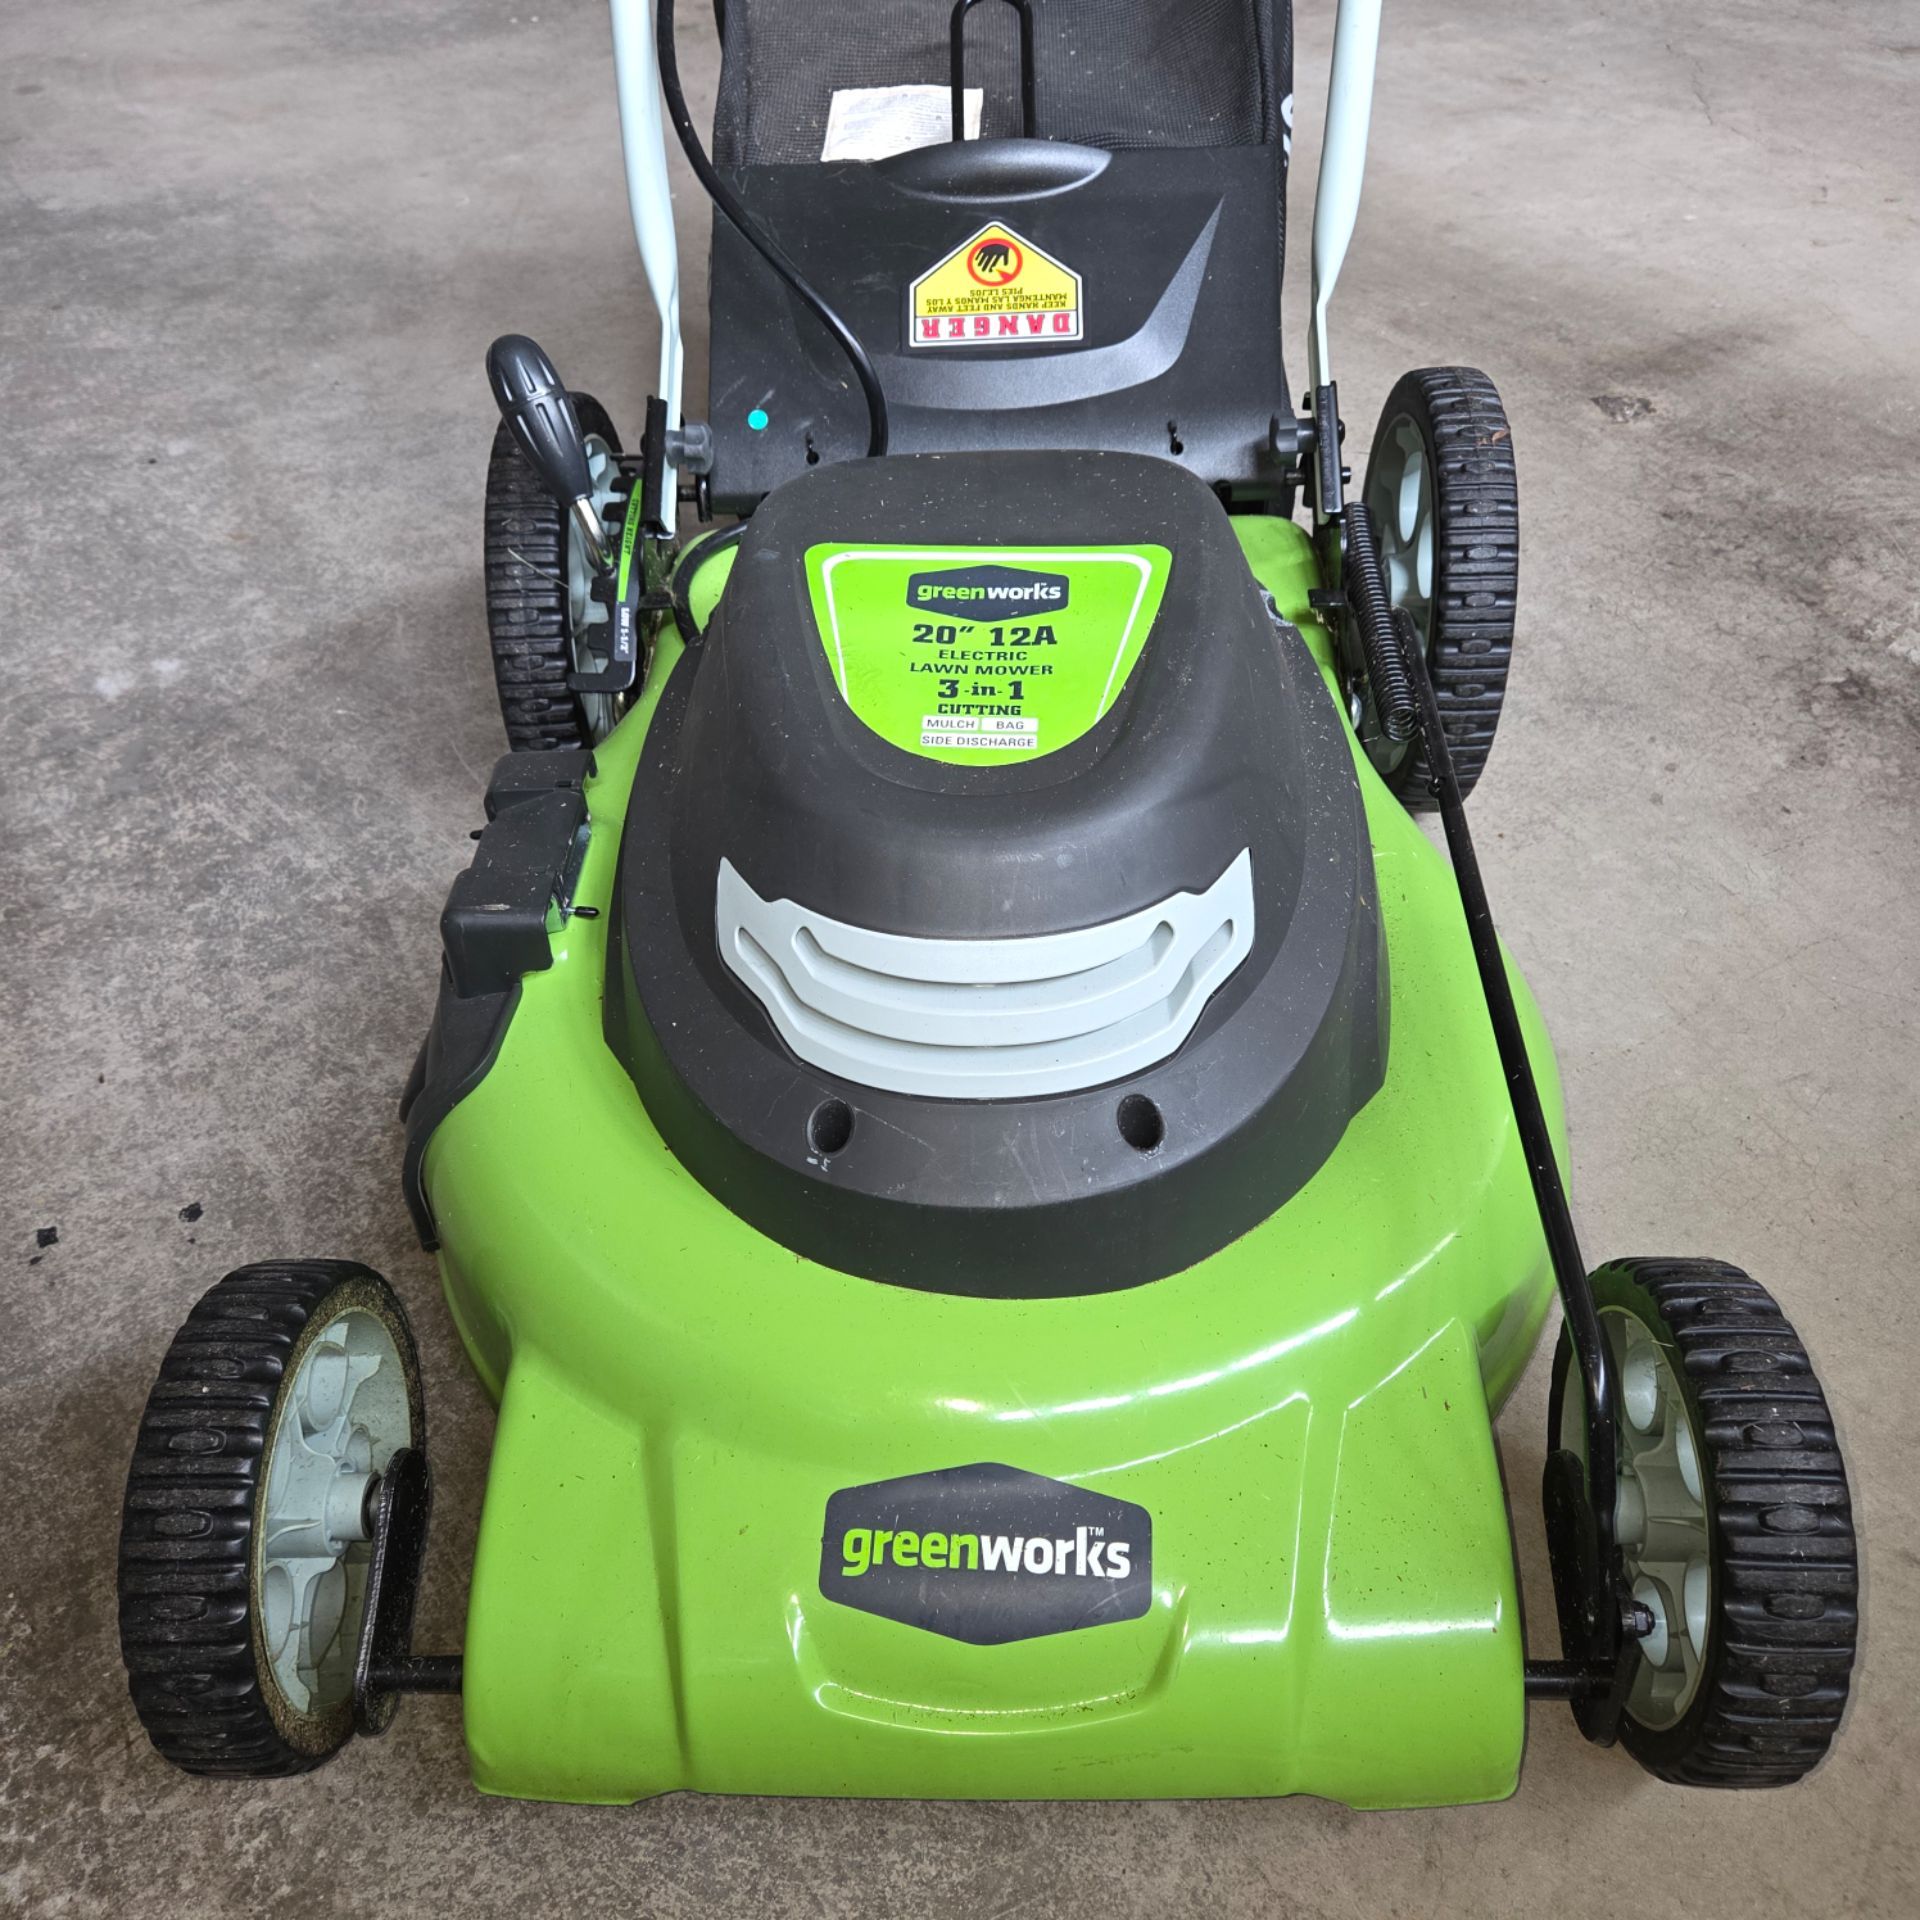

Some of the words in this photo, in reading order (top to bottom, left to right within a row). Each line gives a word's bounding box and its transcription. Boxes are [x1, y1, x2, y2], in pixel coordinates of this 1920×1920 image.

[969, 288, 999, 297] LEJOS
[1001, 287, 1024, 295] PIES
[926, 298, 945, 306] LOS
[946, 297, 952, 305] Y
[954, 296, 989, 305] MANOS
[992, 295, 1010, 304] LAS
[1012, 293, 1067, 303] MANTENGA
[956, 304, 981, 312] FEET
[983, 303, 1004, 311] AND
[1006, 301, 1039, 310] HANDS
[1041, 300, 1066, 309] KEEP
[927, 305, 953, 314] AWAY
[921, 313, 1070, 338] DANGER
[917, 582, 1061, 601] greenworks
[620, 606, 630, 627] LOW
[989, 625, 1058, 646] 12A
[938, 649, 1028, 661] ELECTRIC
[910, 662, 969, 674] LAWN
[975, 665, 1054, 675] MOWER
[937, 703, 1021, 716] CUTTING
[926, 718, 975, 729] MULCH
[996, 721, 1025, 730] BAG
[922, 735, 952, 746] SIDE
[957, 736, 1034, 748] DISCHARGE
[841, 1525, 1131, 1580] greenworks
